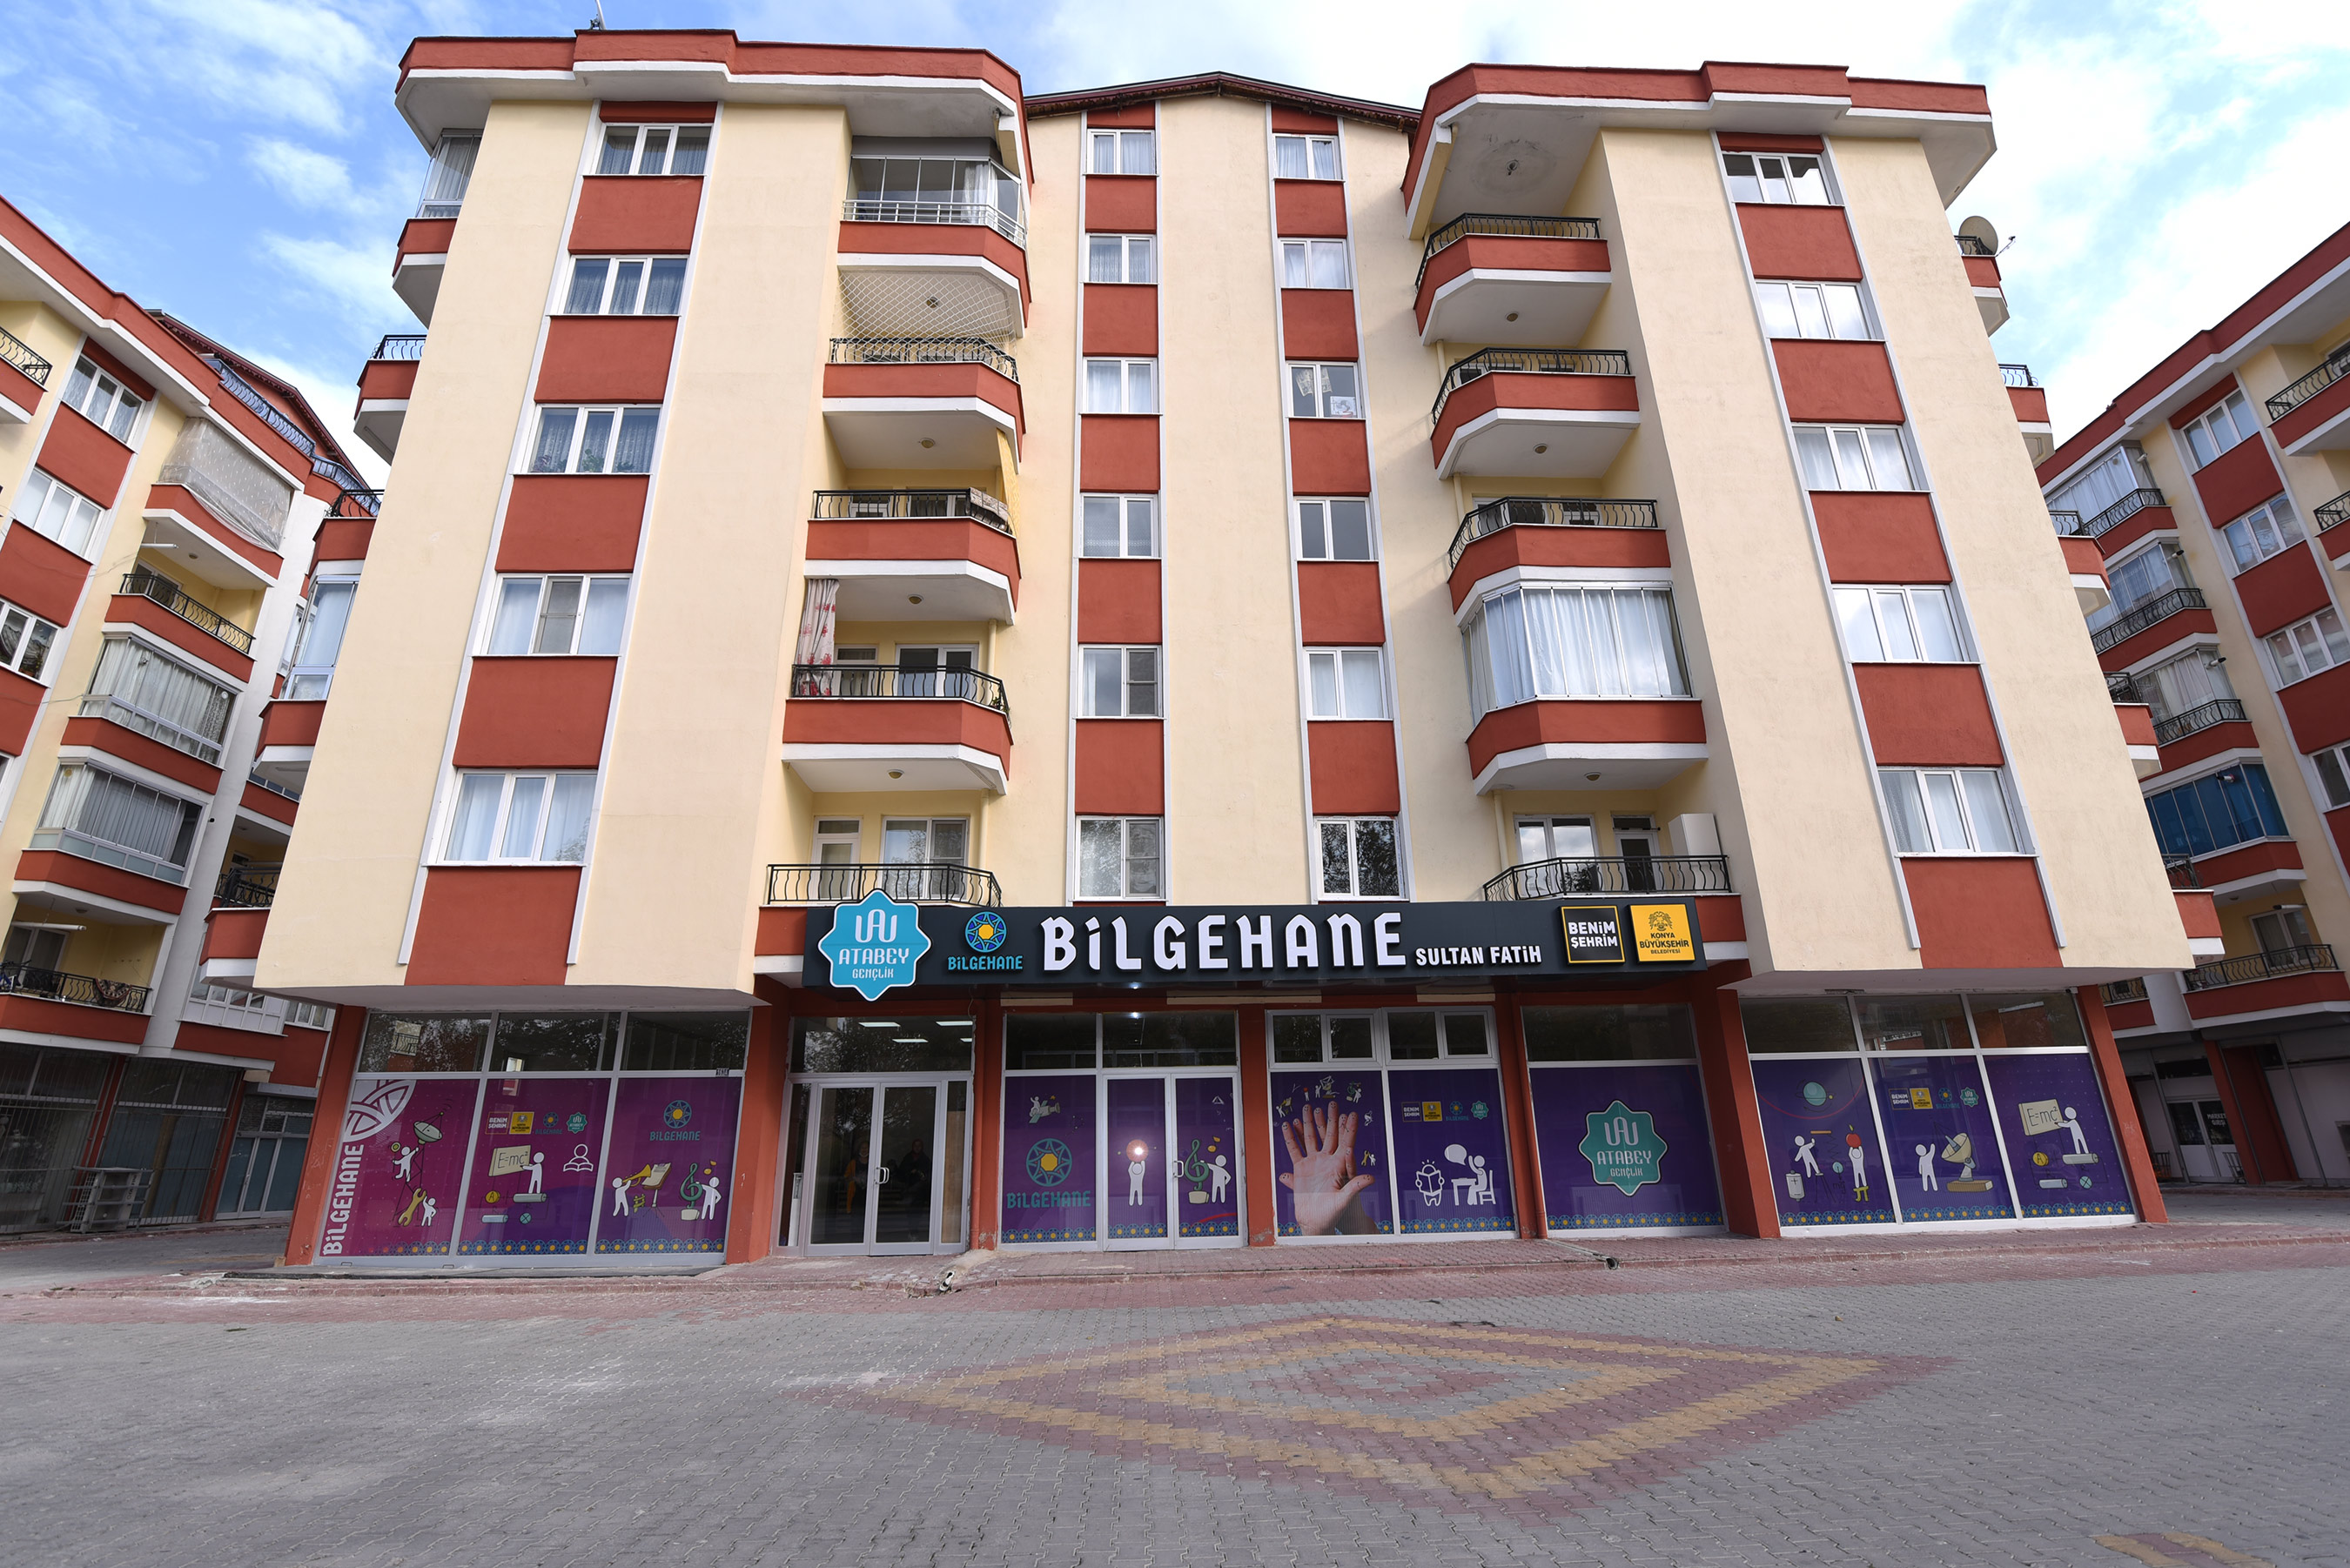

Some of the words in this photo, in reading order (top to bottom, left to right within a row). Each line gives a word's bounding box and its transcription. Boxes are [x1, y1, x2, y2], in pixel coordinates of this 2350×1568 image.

[1570, 934, 1618, 949] ŞEHRİM
[1639, 939, 1690, 949] BÜYÜKŞEHİR
[838, 948, 910, 965] ATABEY
[1415, 946, 1485, 967] SULTAN
[852, 966, 894, 982] GENÇLİK
[1596, 1149, 1652, 1165] ATABEY
[1609, 1166, 1643, 1179] GENÇLİK
